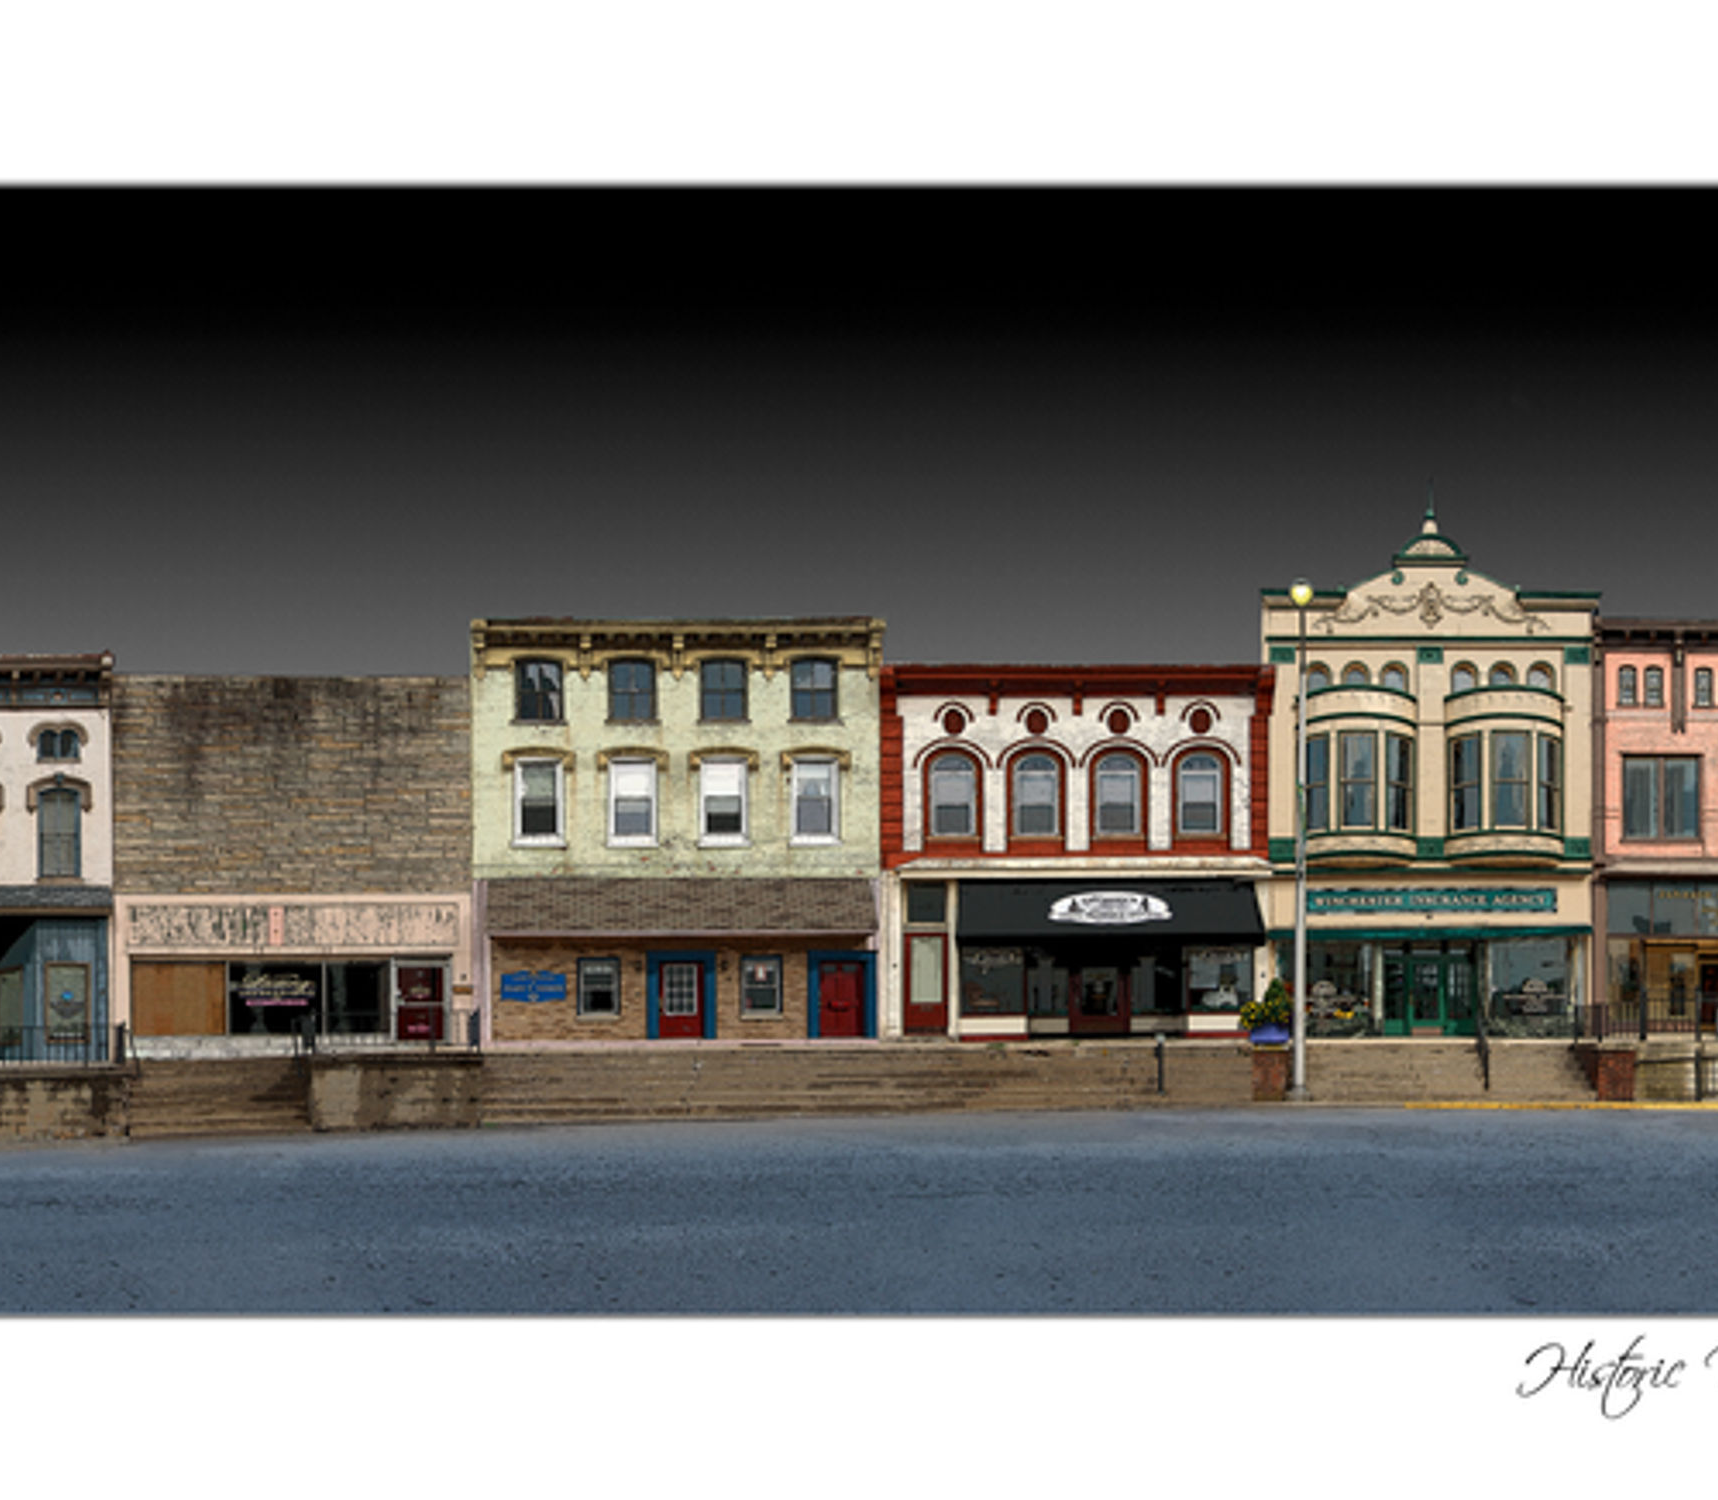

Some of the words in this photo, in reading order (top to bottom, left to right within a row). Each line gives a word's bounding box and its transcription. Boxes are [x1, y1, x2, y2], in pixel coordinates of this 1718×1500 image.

[1315, 895, 1403, 906] WINCHESTER
[1409, 895, 1487, 906] INSURANCE
[1492, 895, 1546, 906] AGENCY
